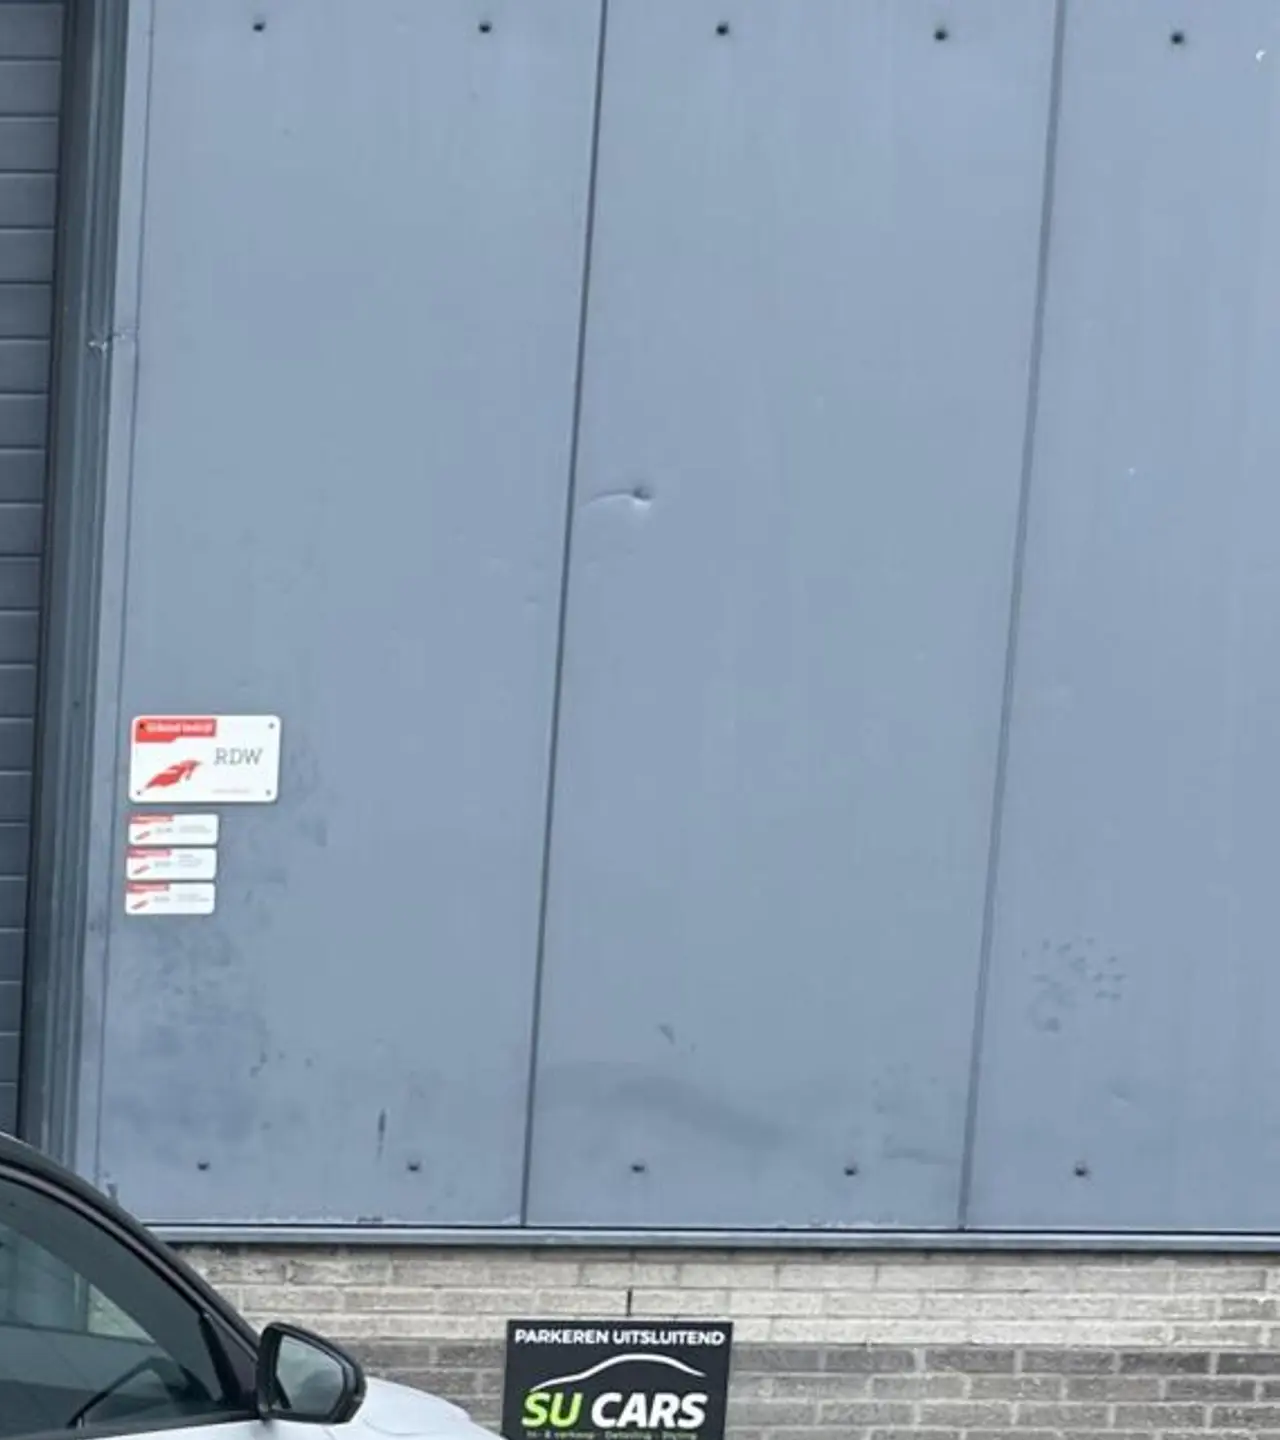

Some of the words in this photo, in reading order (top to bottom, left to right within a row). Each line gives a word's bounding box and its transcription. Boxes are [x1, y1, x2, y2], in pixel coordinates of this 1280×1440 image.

[214, 747, 263, 765] RDW
[515, 1329, 609, 1343] PARKEREN
[613, 1330, 725, 1346] UITSLUITEND
[522, 1392, 583, 1427] SU
[591, 1392, 708, 1429] CARS
